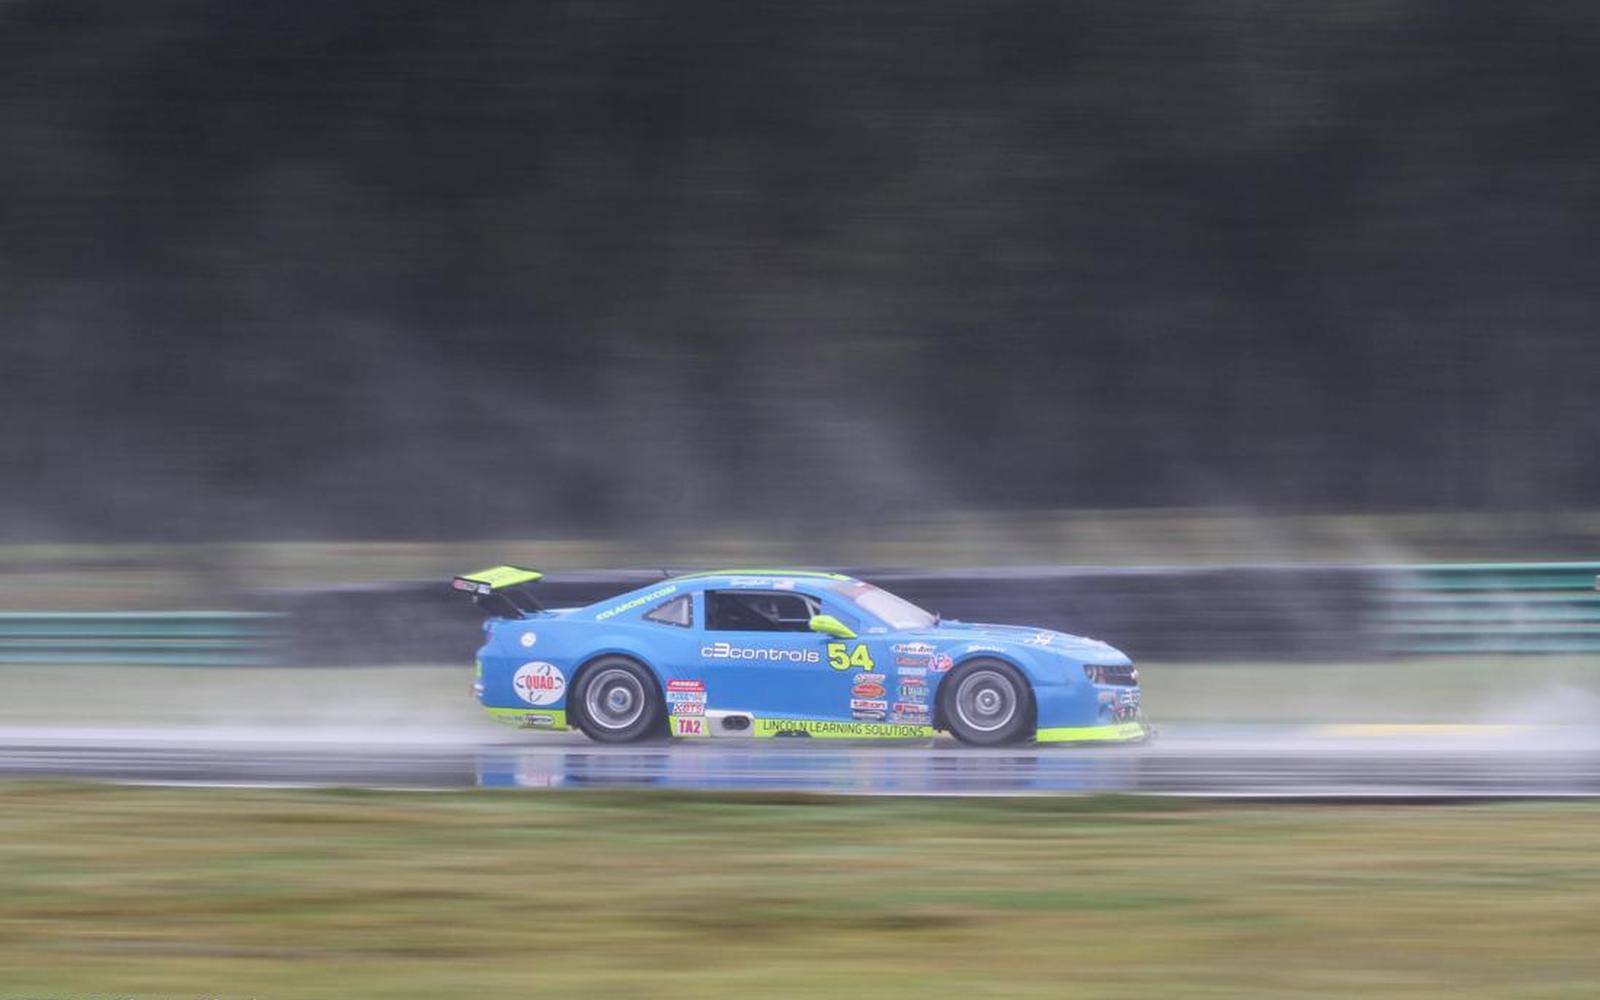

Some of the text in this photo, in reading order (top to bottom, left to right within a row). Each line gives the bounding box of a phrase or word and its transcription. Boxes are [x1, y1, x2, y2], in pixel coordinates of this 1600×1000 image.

[701, 642, 820, 664] c3controls
[826, 643, 875, 673] 54
[526, 675, 554, 690] QUAD
[679, 719, 702, 735] TA2
[763, 719, 925, 737] LINCOLN LEARNING SOLUTIONS
